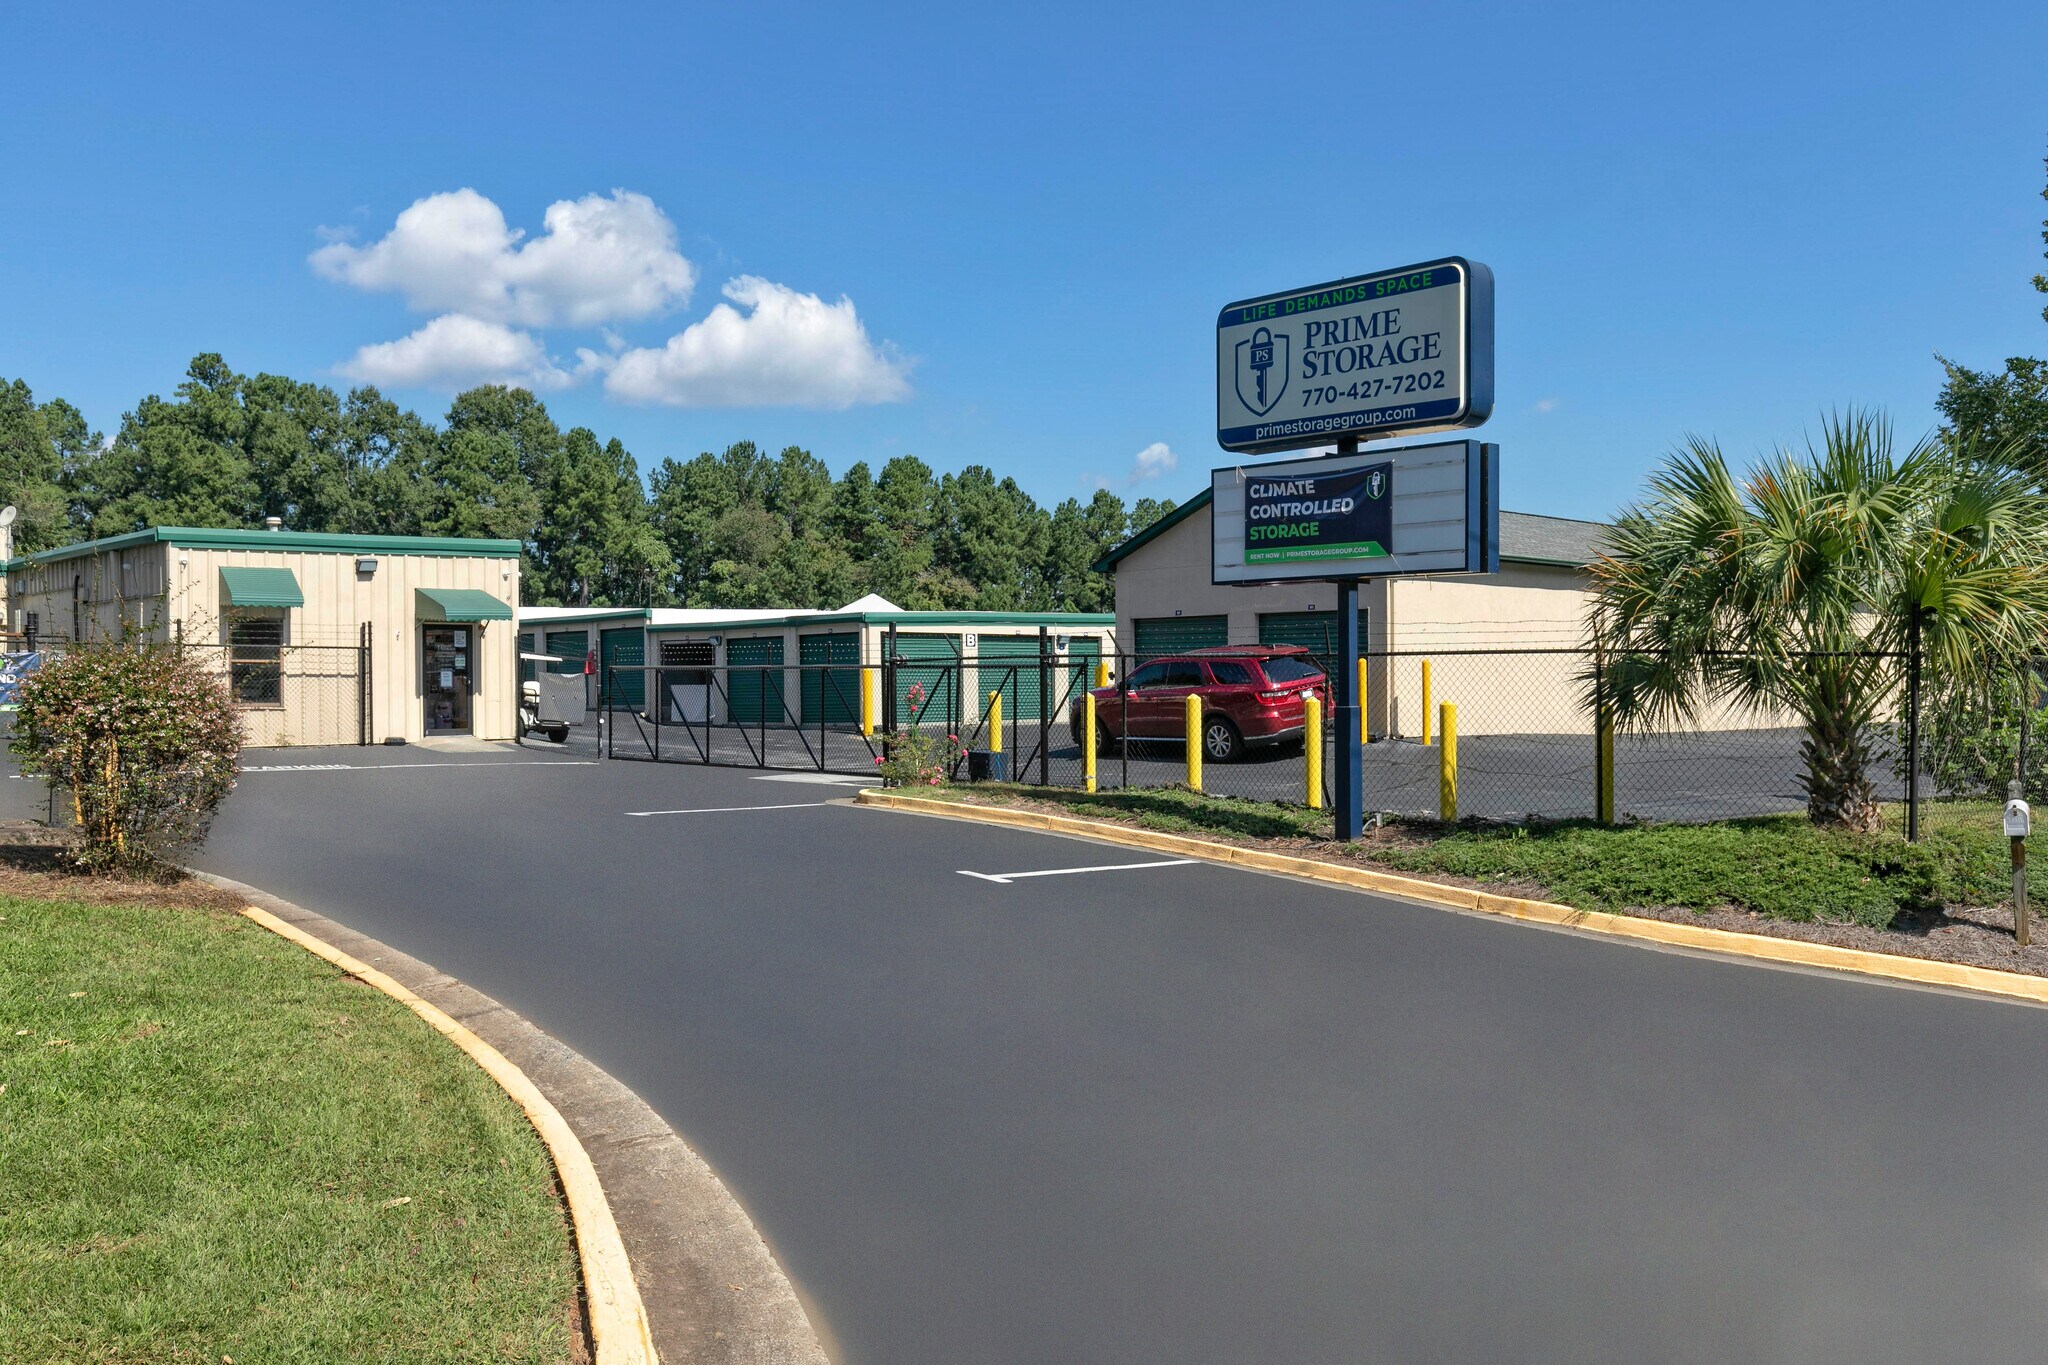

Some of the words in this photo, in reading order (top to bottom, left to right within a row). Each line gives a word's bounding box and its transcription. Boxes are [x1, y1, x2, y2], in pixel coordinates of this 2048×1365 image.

[1243, 303, 1276, 322] LIFE
[1285, 287, 1367, 314] DEMANDS
[1376, 272, 1433, 296] SPACE
[1303, 308, 1401, 350] PRIME
[1255, 349, 1269, 362] PS
[1302, 331, 1442, 379] STORAGE
[1302, 369, 1445, 407] 770-427-7202
[1255, 406, 1416, 440] primestoragegroup.com
[1250, 479, 1315, 499] CLIMATE
[1250, 497, 1354, 520] CONTROLLED
[1250, 521, 1319, 541] STORAGE
[1286, 547, 1369, 558] PRIMESTORAGEGROUP.COM
[965, 633, 976, 647] B
